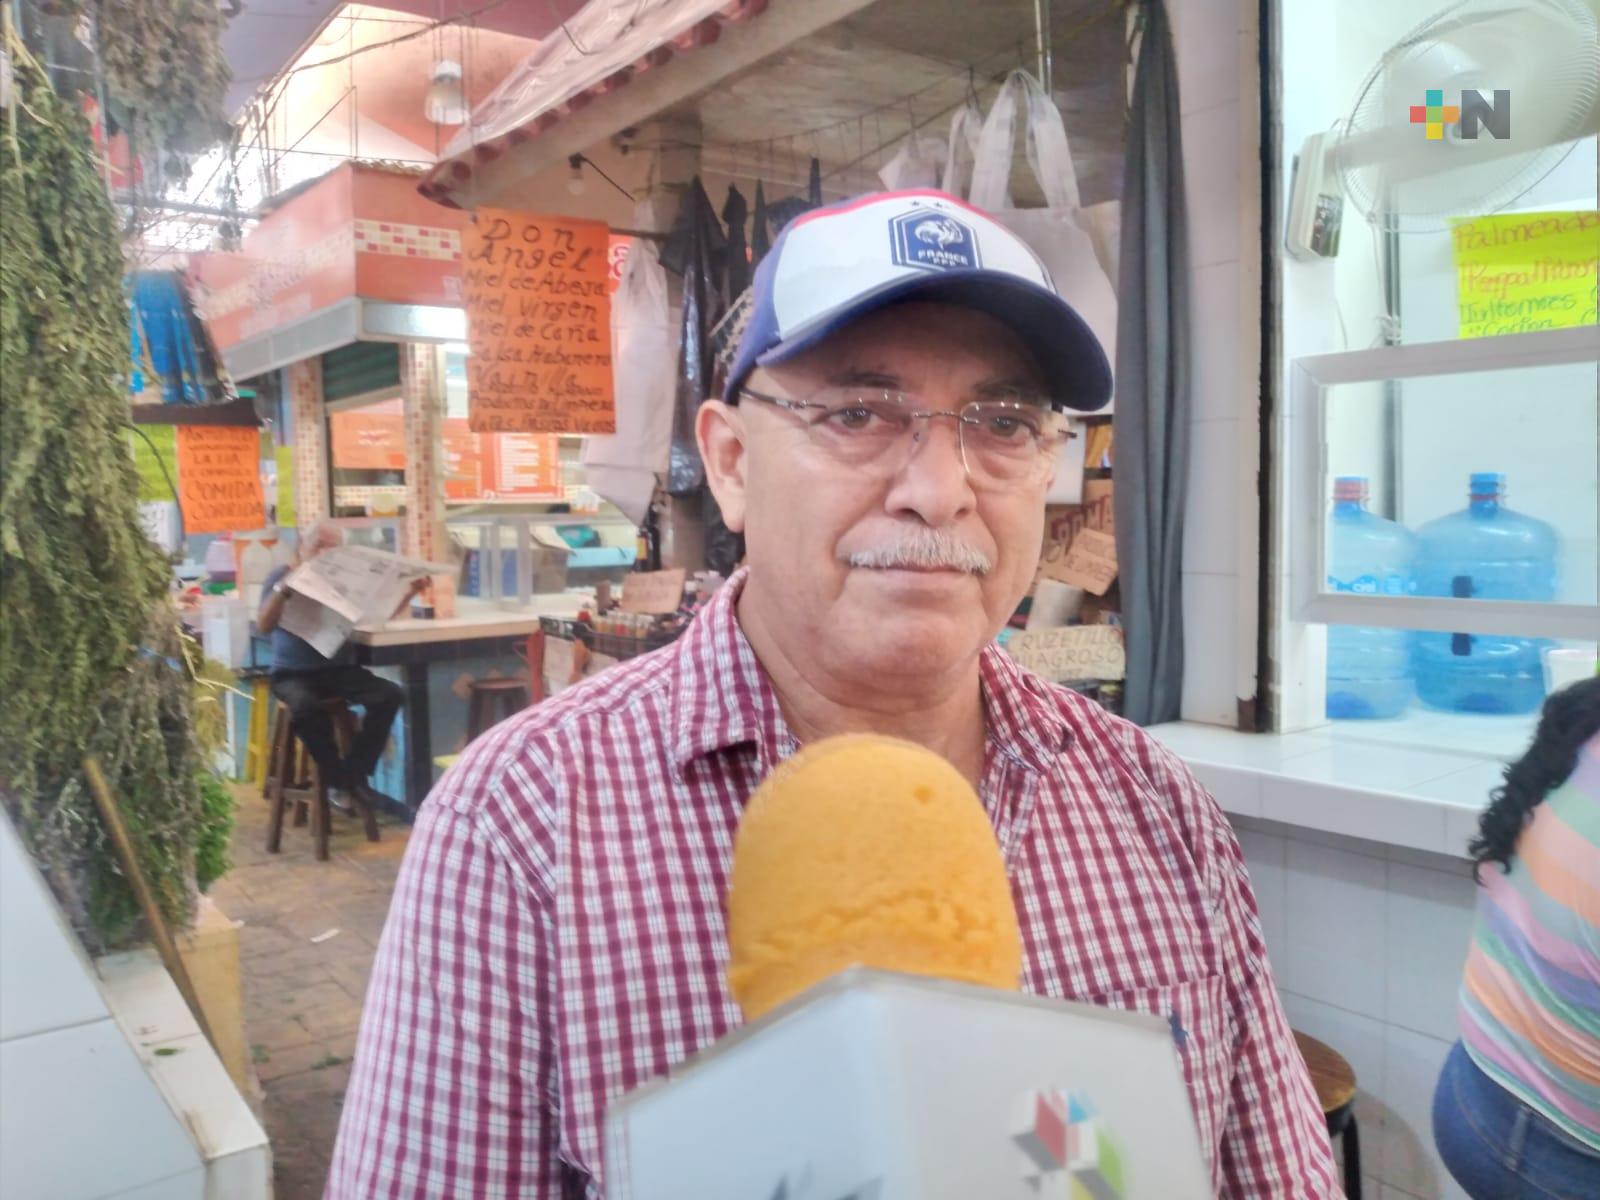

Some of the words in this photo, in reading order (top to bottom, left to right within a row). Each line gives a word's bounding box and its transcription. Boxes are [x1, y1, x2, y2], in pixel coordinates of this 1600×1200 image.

[918, 249, 969, 266] FRANCE
[468, 294, 507, 313] Miel
[185, 479, 257, 501] COMIDA
